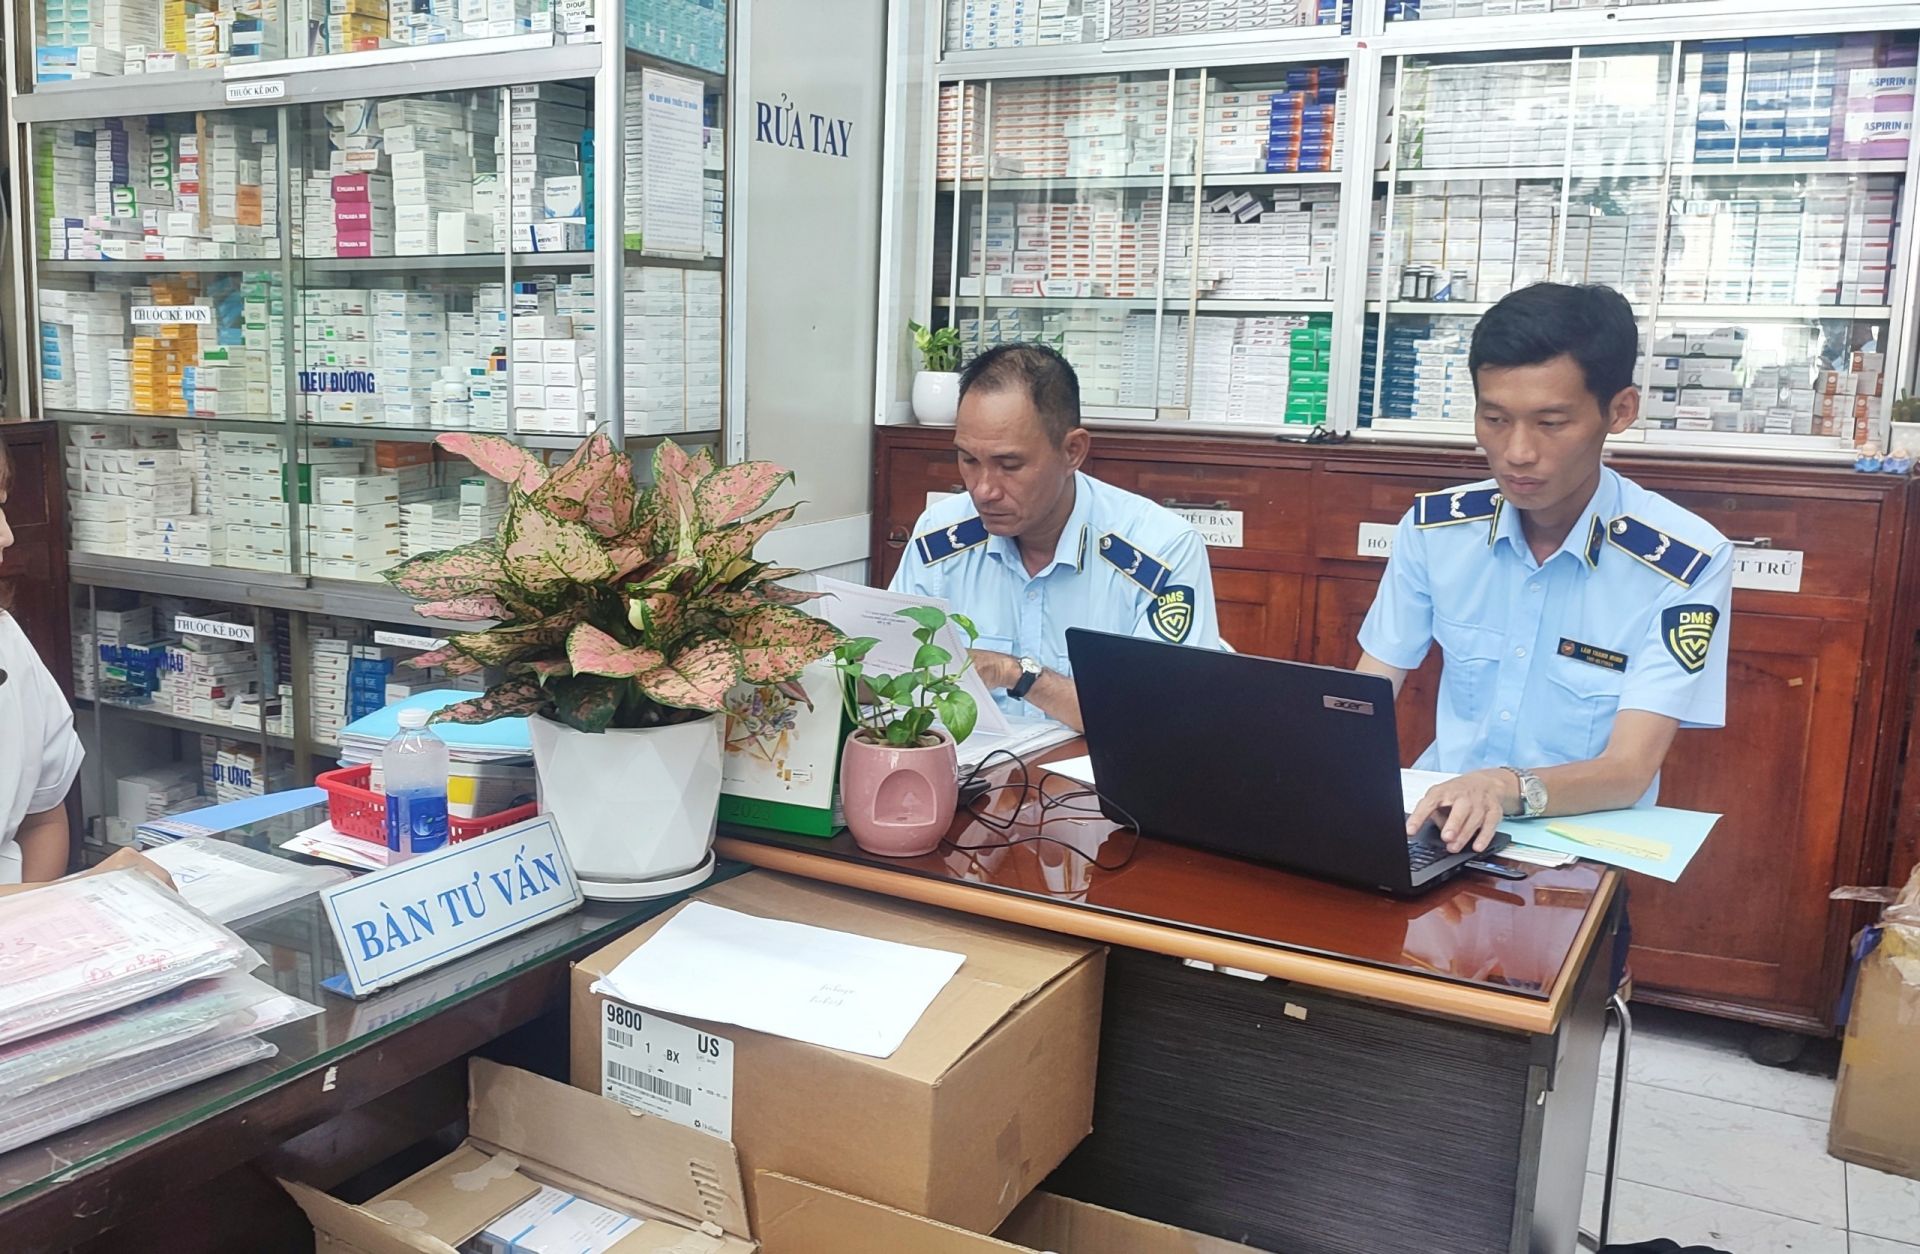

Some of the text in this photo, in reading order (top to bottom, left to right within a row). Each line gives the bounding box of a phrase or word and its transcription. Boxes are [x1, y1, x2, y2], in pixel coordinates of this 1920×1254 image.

[1868, 77, 1906, 87] ASPIRIN
[756, 93, 853, 157] RỬA TAY
[1864, 121, 1902, 131] ASPIRIN
[1754, 552, 1797, 575] TRỮ
[1157, 590, 1184, 606] DMS
[1679, 612, 1713, 624] DMS
[177, 619, 211, 633] THUỐC
[228, 627, 251, 640] ĐƠN
[1334, 700, 1360, 711] acer
[352, 845, 561, 962] BÀN TƯ VẤN
[607, 1004, 642, 1031] 9800
[645, 1042, 680, 1064] 1 BX
[697, 1034, 720, 1057] US
